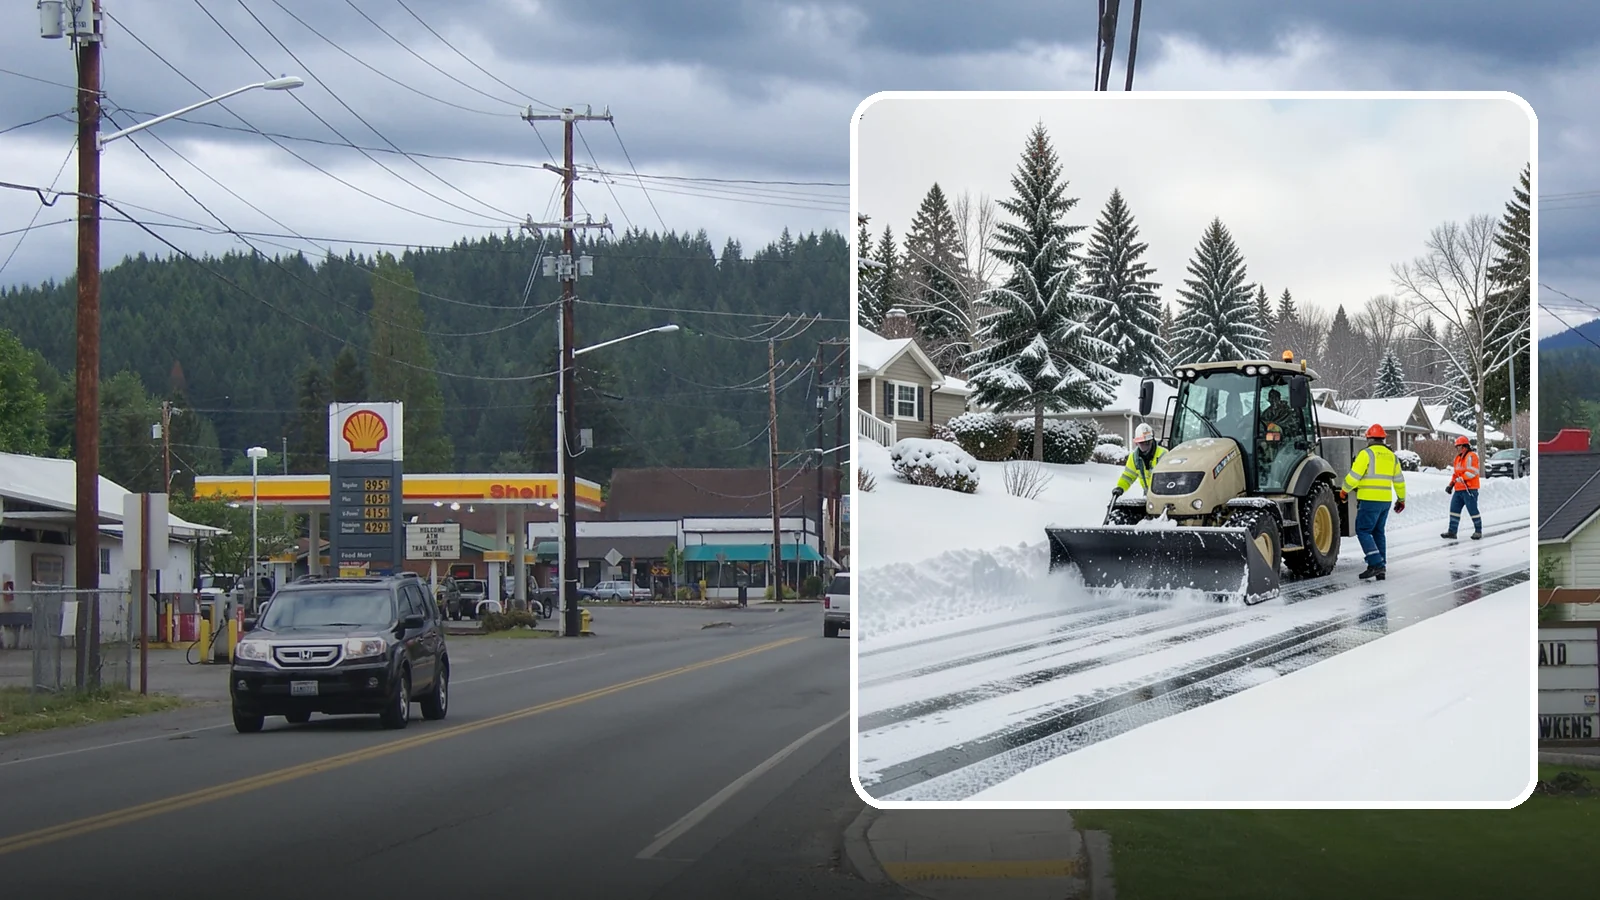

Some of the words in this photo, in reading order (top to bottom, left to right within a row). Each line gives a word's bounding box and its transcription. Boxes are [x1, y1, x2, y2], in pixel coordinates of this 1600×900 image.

[365, 480, 383, 490] 395
[490, 485, 547, 499] Shell
[366, 494, 383, 504] 405
[365, 508, 383, 518] 415
[366, 522, 383, 532] 429
